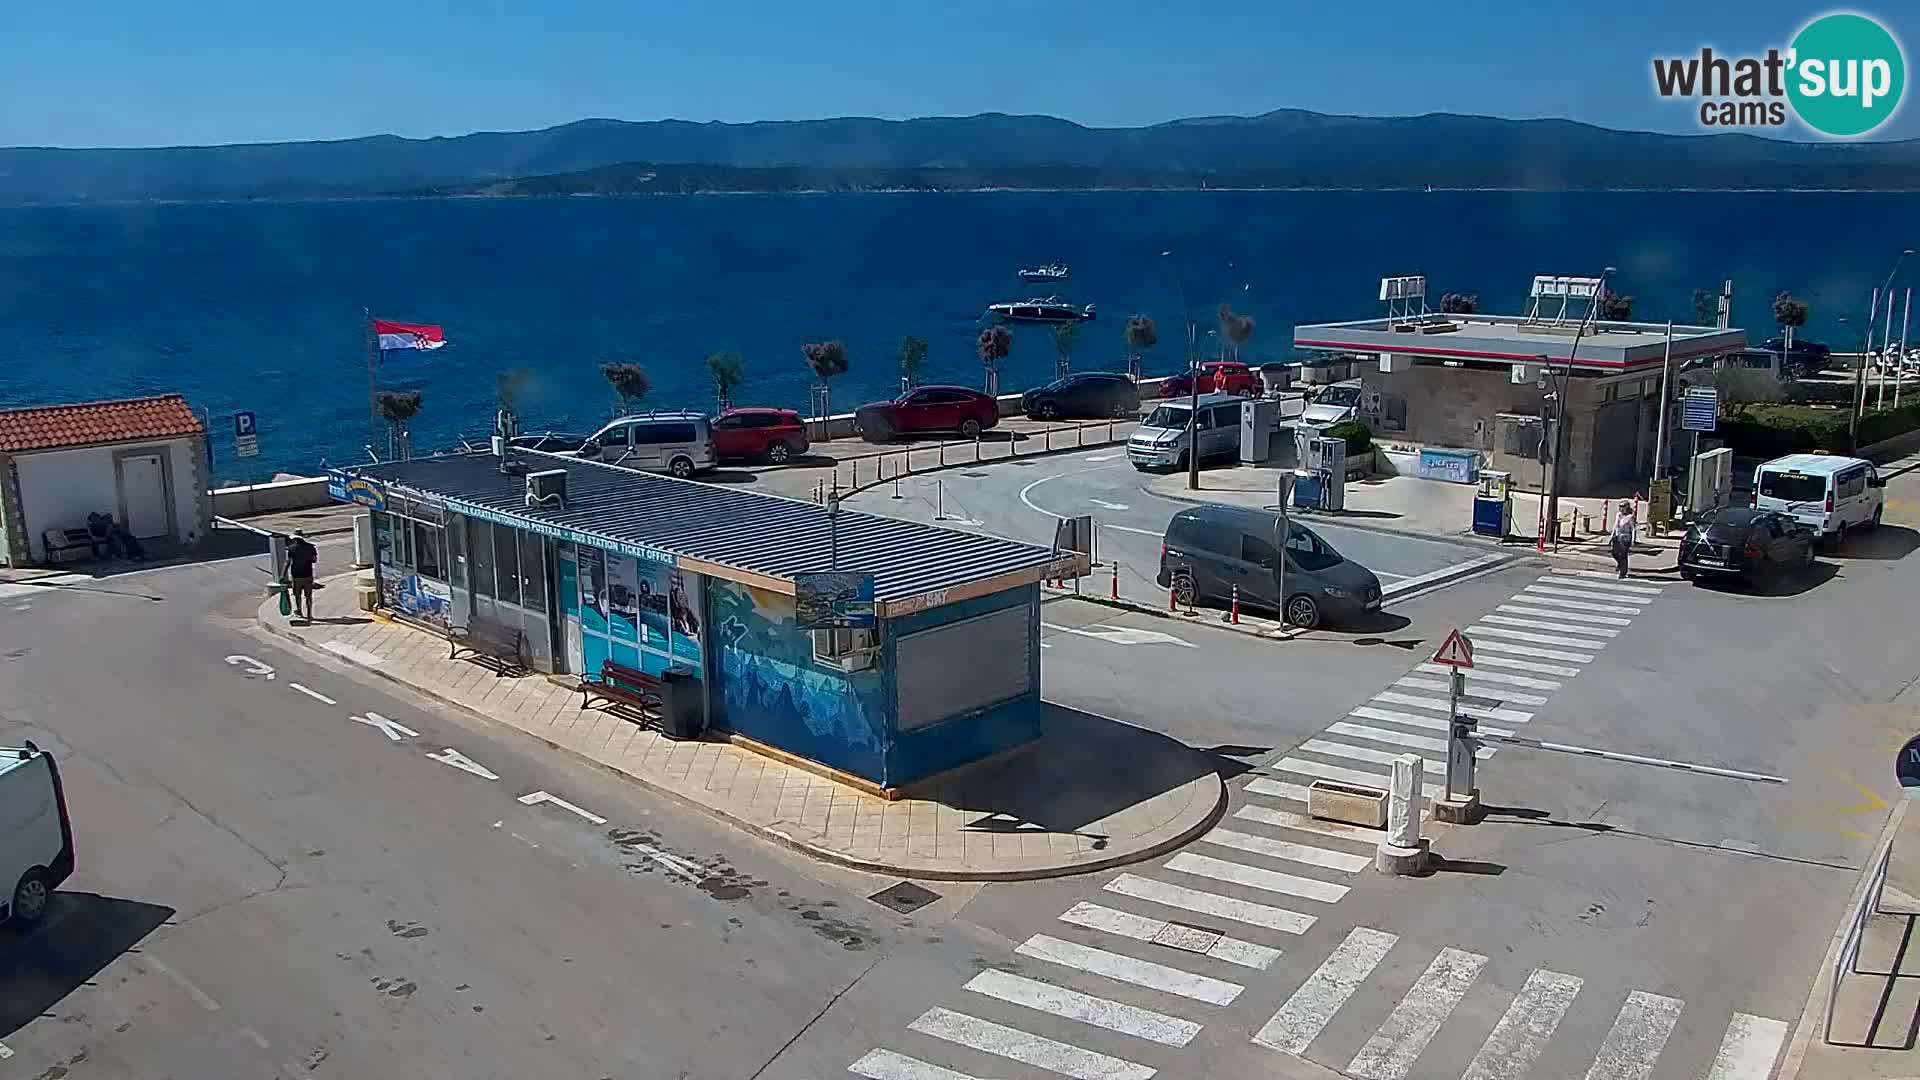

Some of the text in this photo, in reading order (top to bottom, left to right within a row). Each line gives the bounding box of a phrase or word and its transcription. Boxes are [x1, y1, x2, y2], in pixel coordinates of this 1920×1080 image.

[239, 415, 251, 433] P
[572, 532, 586, 544] BUS
[588, 537, 618, 551] STATION
[620, 543, 646, 557] TICKET
[647, 550, 673, 564] OFFICE
